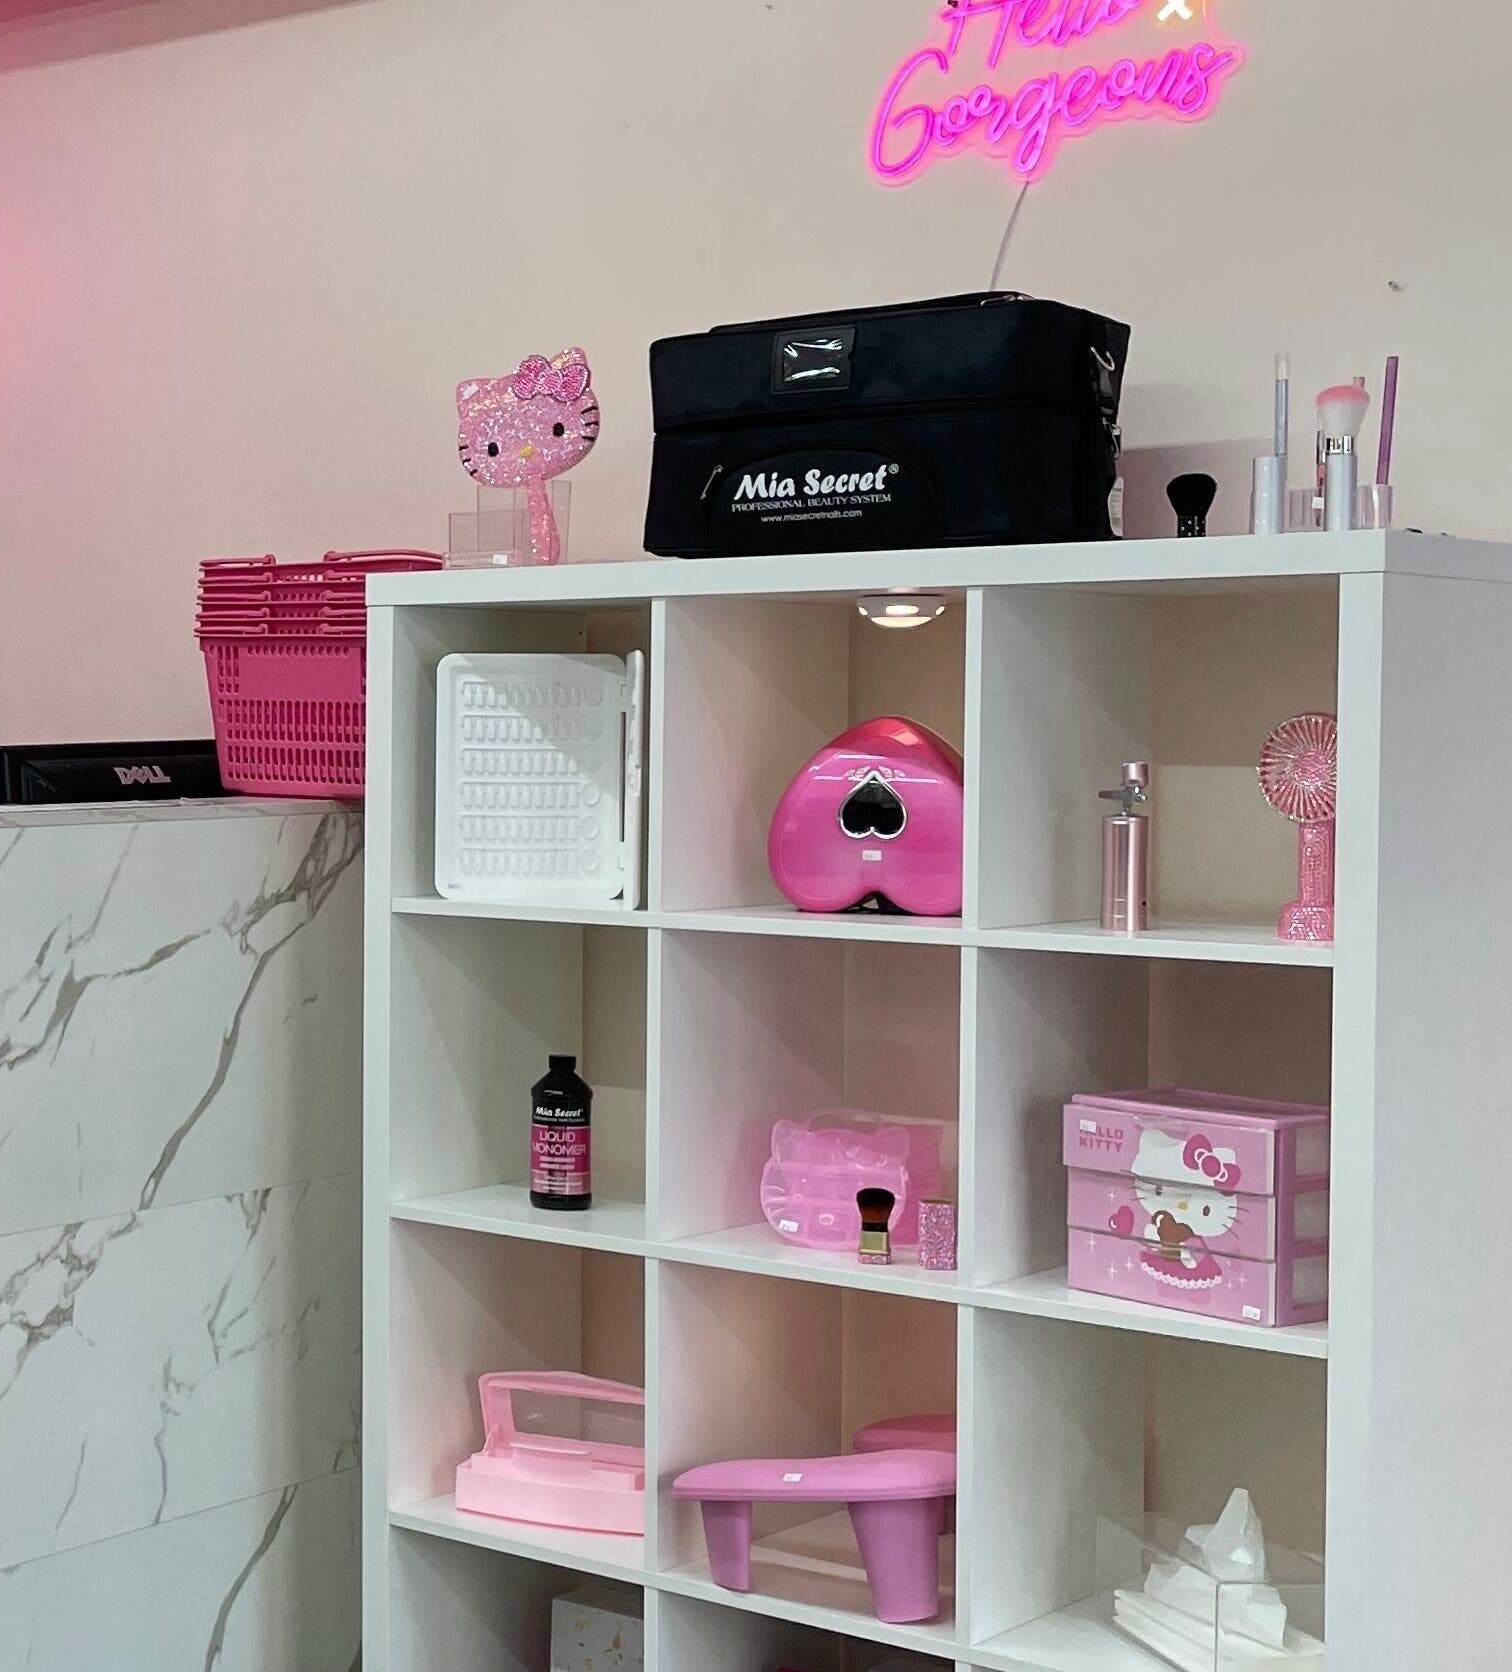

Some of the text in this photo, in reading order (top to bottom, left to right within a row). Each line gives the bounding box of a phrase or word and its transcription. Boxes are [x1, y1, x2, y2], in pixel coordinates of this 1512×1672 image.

[872, 44, 1233, 174] Gorgeous
[734, 472, 796, 500] Mia
[731, 494, 892, 512] PROFESSIONAL BEAUTY SYSTEM
[113, 765, 171, 784] DELL
[539, 1131, 576, 1142] LIQUID
[1079, 1136, 1123, 1152] KITTY
